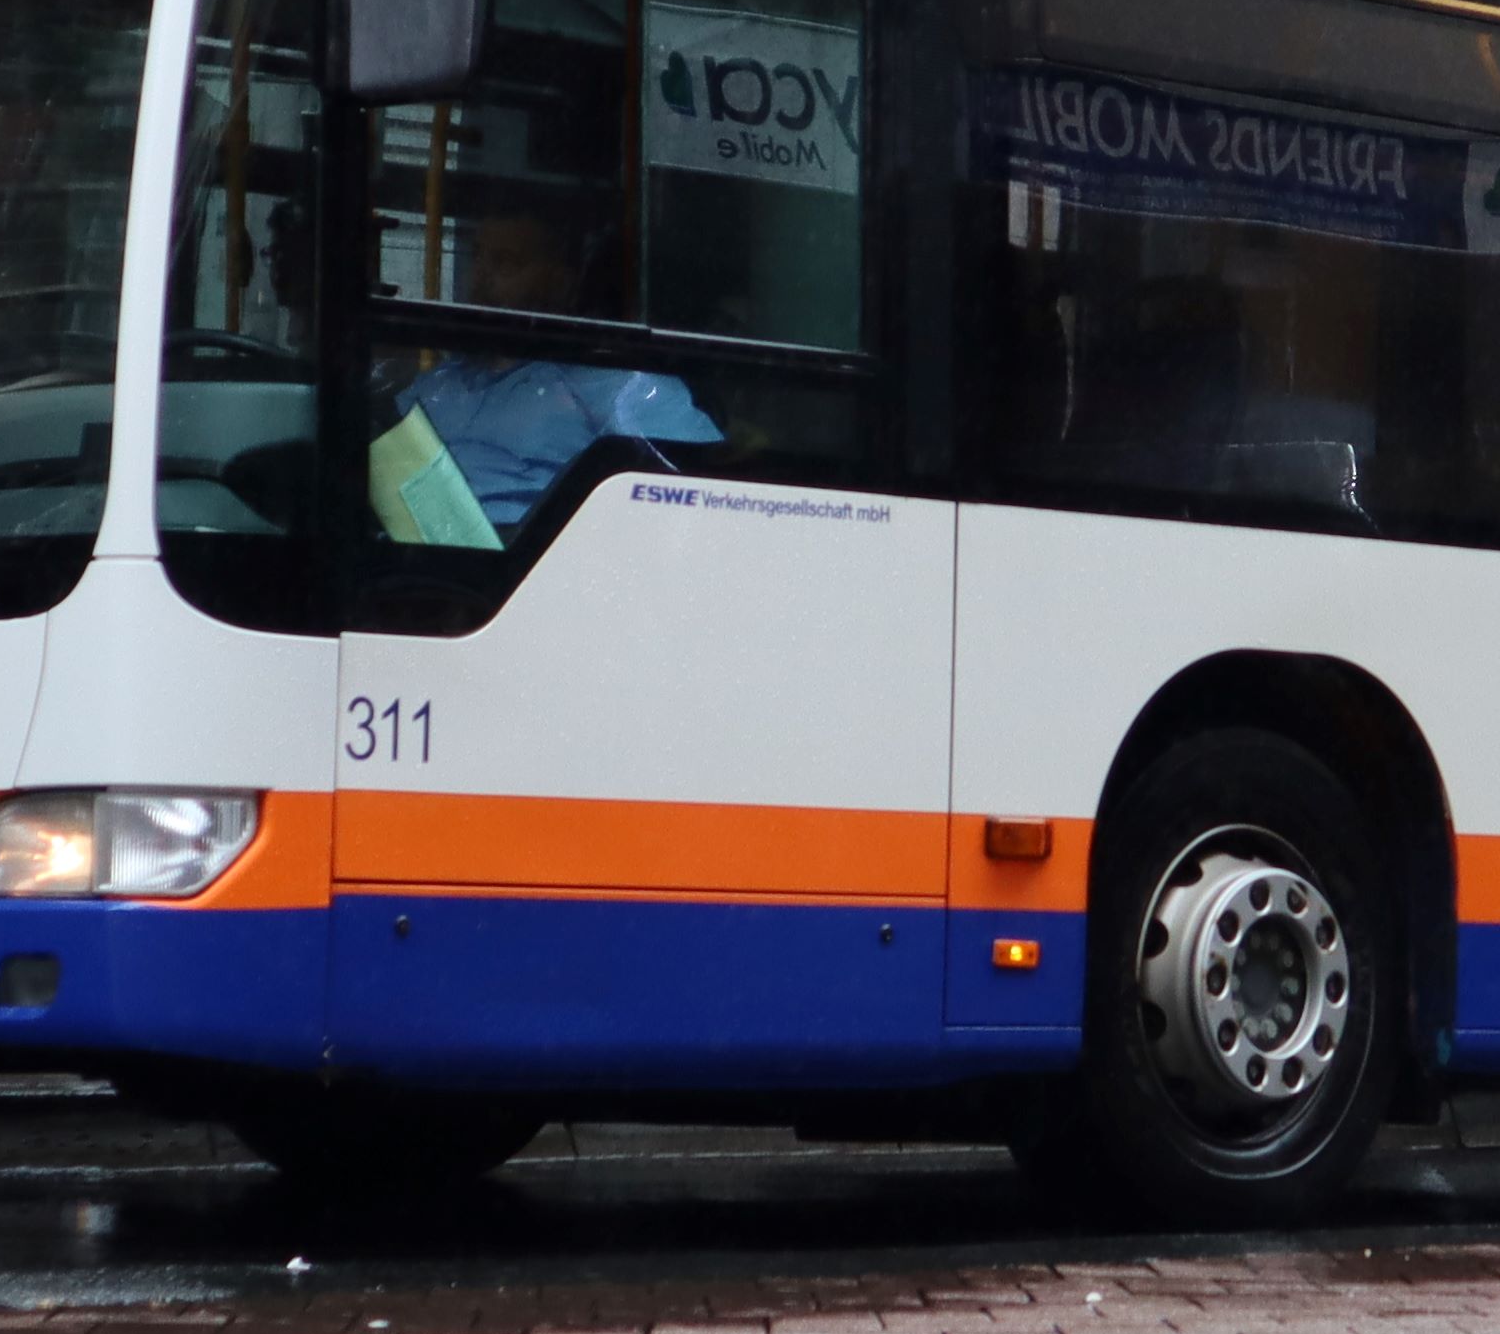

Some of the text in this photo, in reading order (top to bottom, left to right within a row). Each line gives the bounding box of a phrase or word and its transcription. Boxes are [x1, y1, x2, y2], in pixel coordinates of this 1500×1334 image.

[630, 483, 892, 524] ESWE Verkehrsgesellschaft mbH
[345, 695, 432, 765] 311
